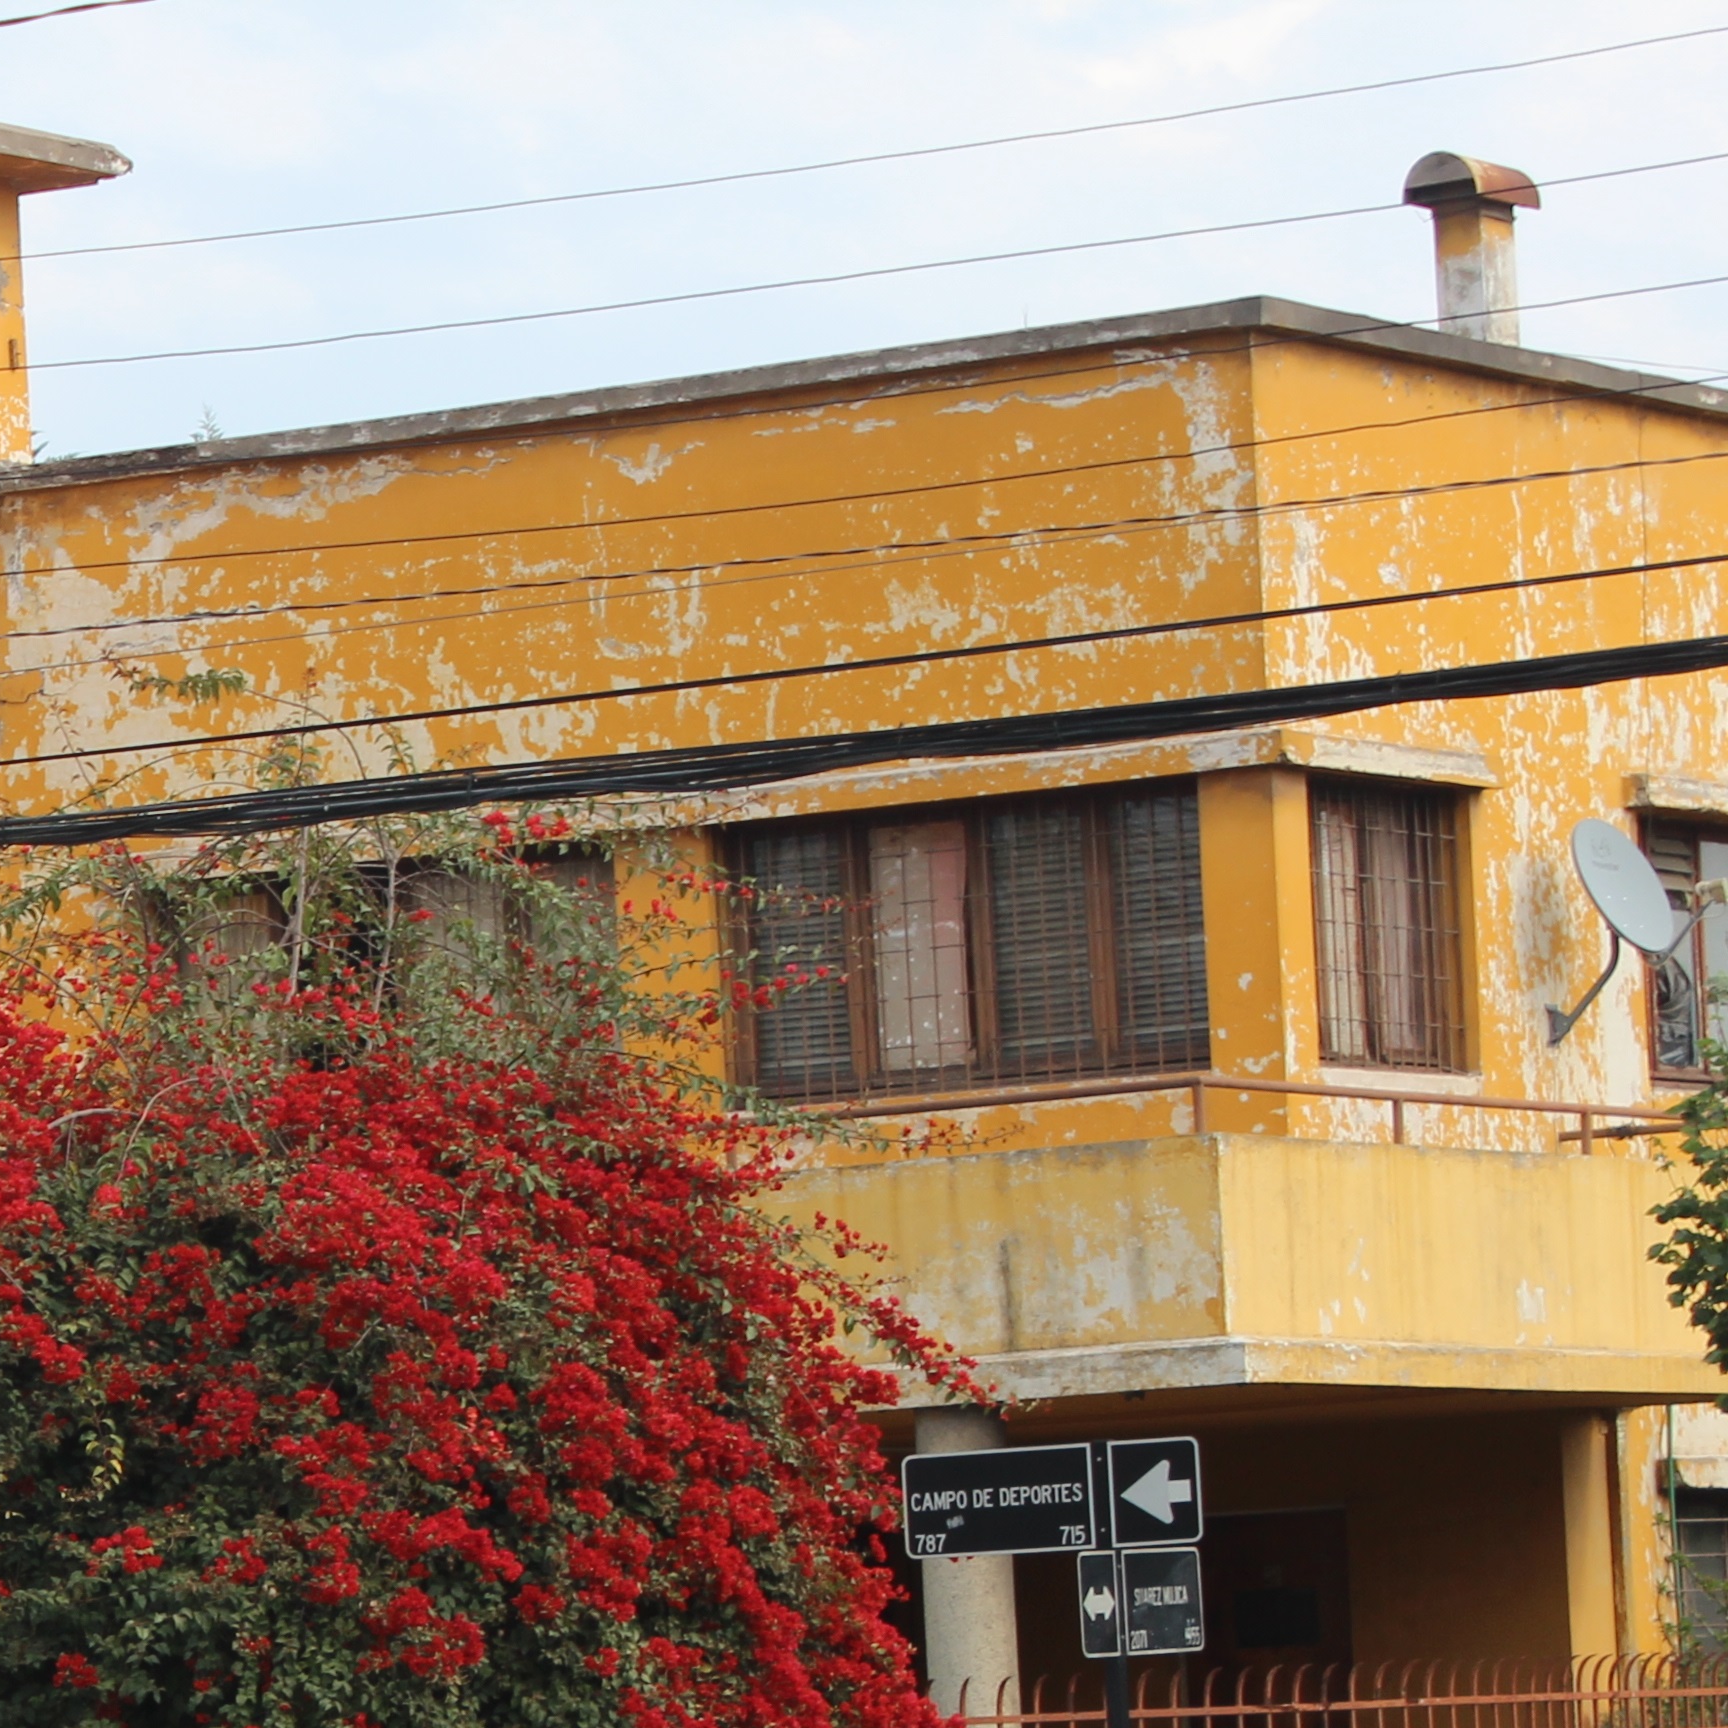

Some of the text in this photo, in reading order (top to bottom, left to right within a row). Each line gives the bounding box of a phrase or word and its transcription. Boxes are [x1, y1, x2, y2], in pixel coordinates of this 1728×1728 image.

[910, 1483, 1084, 1512] CAMPO DE DEPORTES
[914, 1533, 946, 1554] 787
[1059, 1525, 1086, 1545] 715
